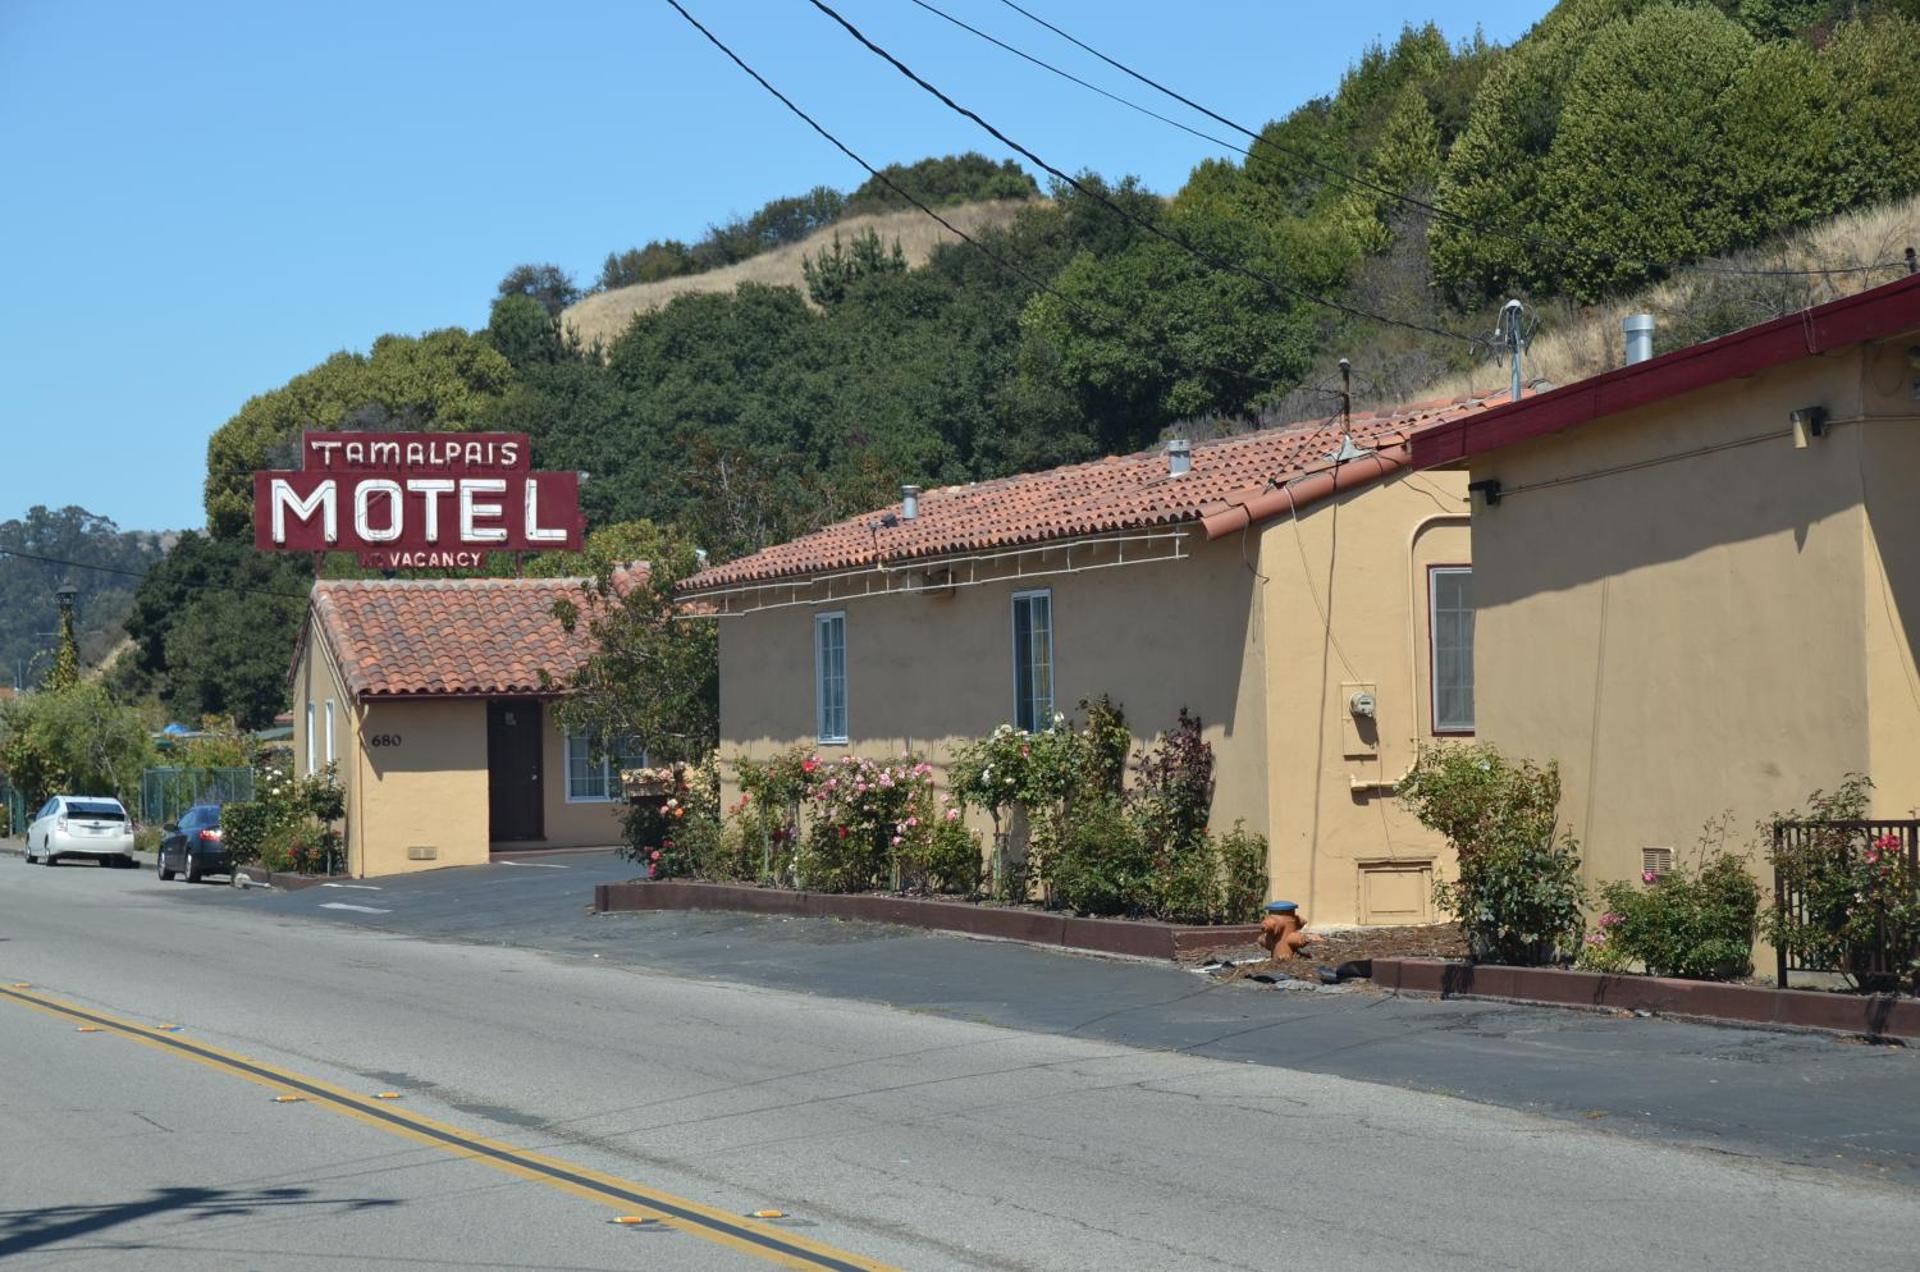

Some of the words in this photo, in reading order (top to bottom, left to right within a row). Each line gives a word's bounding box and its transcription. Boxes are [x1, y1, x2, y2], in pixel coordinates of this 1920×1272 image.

[311, 441, 519, 465] TAMALPAIS
[271, 478, 567, 542] MOTEL
[389, 552, 481, 567] VACANCY
[372, 735, 402, 747] 680
